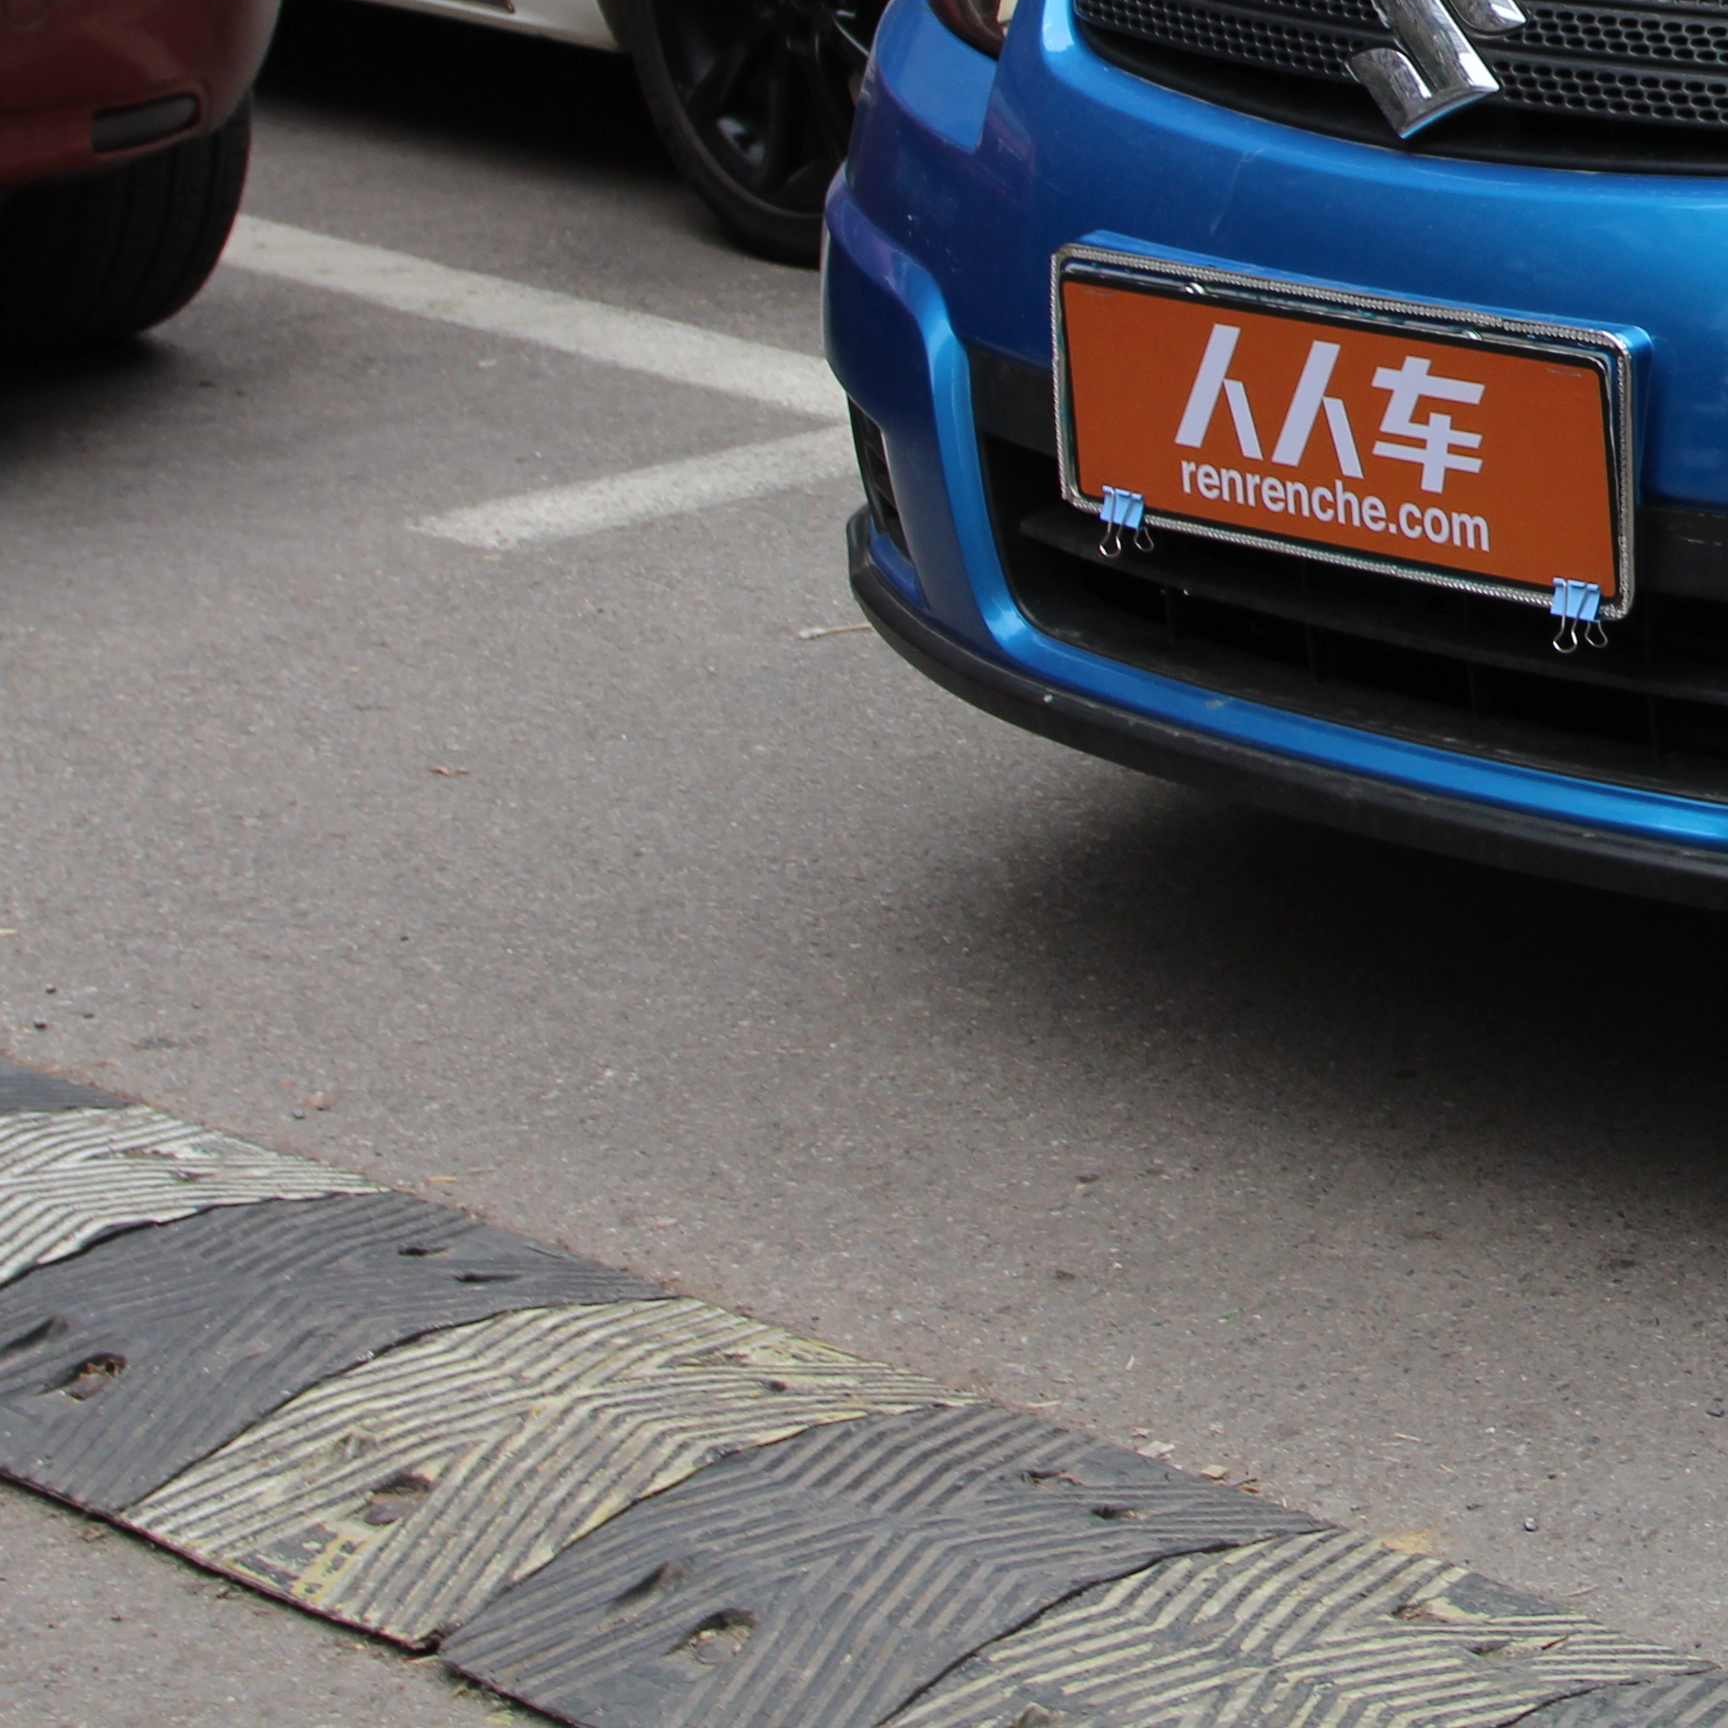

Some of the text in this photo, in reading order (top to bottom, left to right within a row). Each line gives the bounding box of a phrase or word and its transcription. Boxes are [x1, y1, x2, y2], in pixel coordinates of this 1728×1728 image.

[1173, 323, 1487, 494] 人人车
[1180, 459, 1490, 553] renrenche.com
